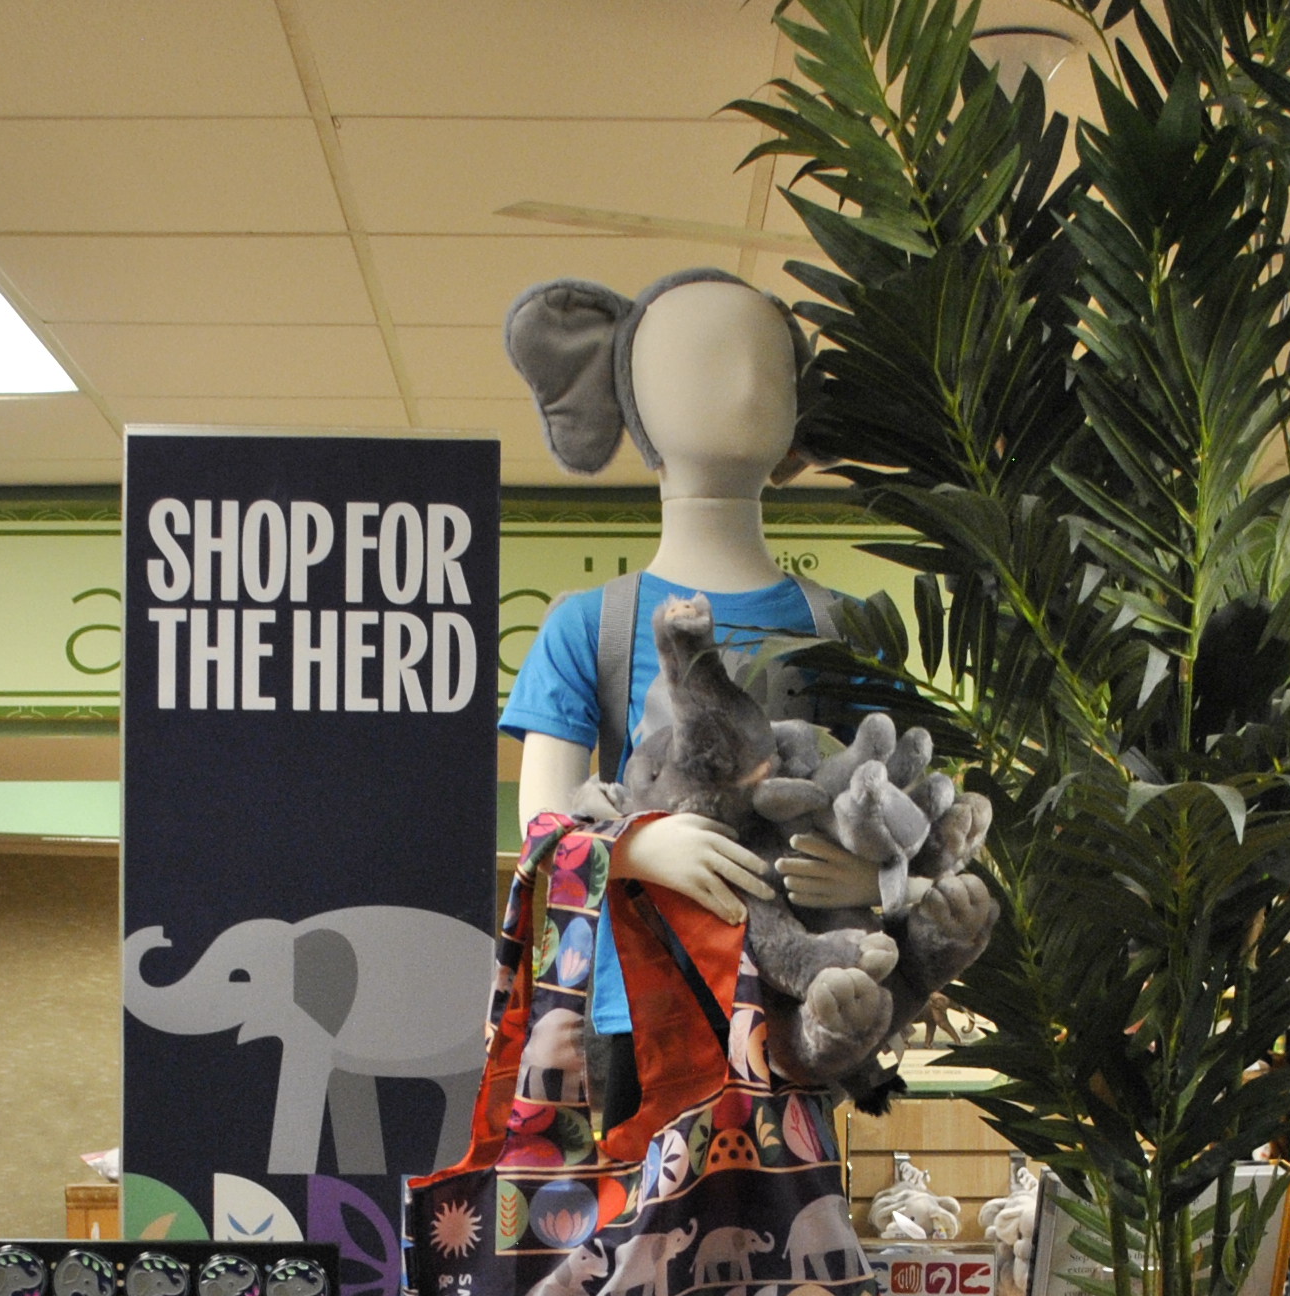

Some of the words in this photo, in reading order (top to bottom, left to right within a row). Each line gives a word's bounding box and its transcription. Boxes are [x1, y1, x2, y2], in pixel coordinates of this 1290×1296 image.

[147, 498, 335, 604] SHOP
[345, 502, 473, 605] FOR
[147, 608, 277, 711] THE
[292, 611, 478, 714] HERD
